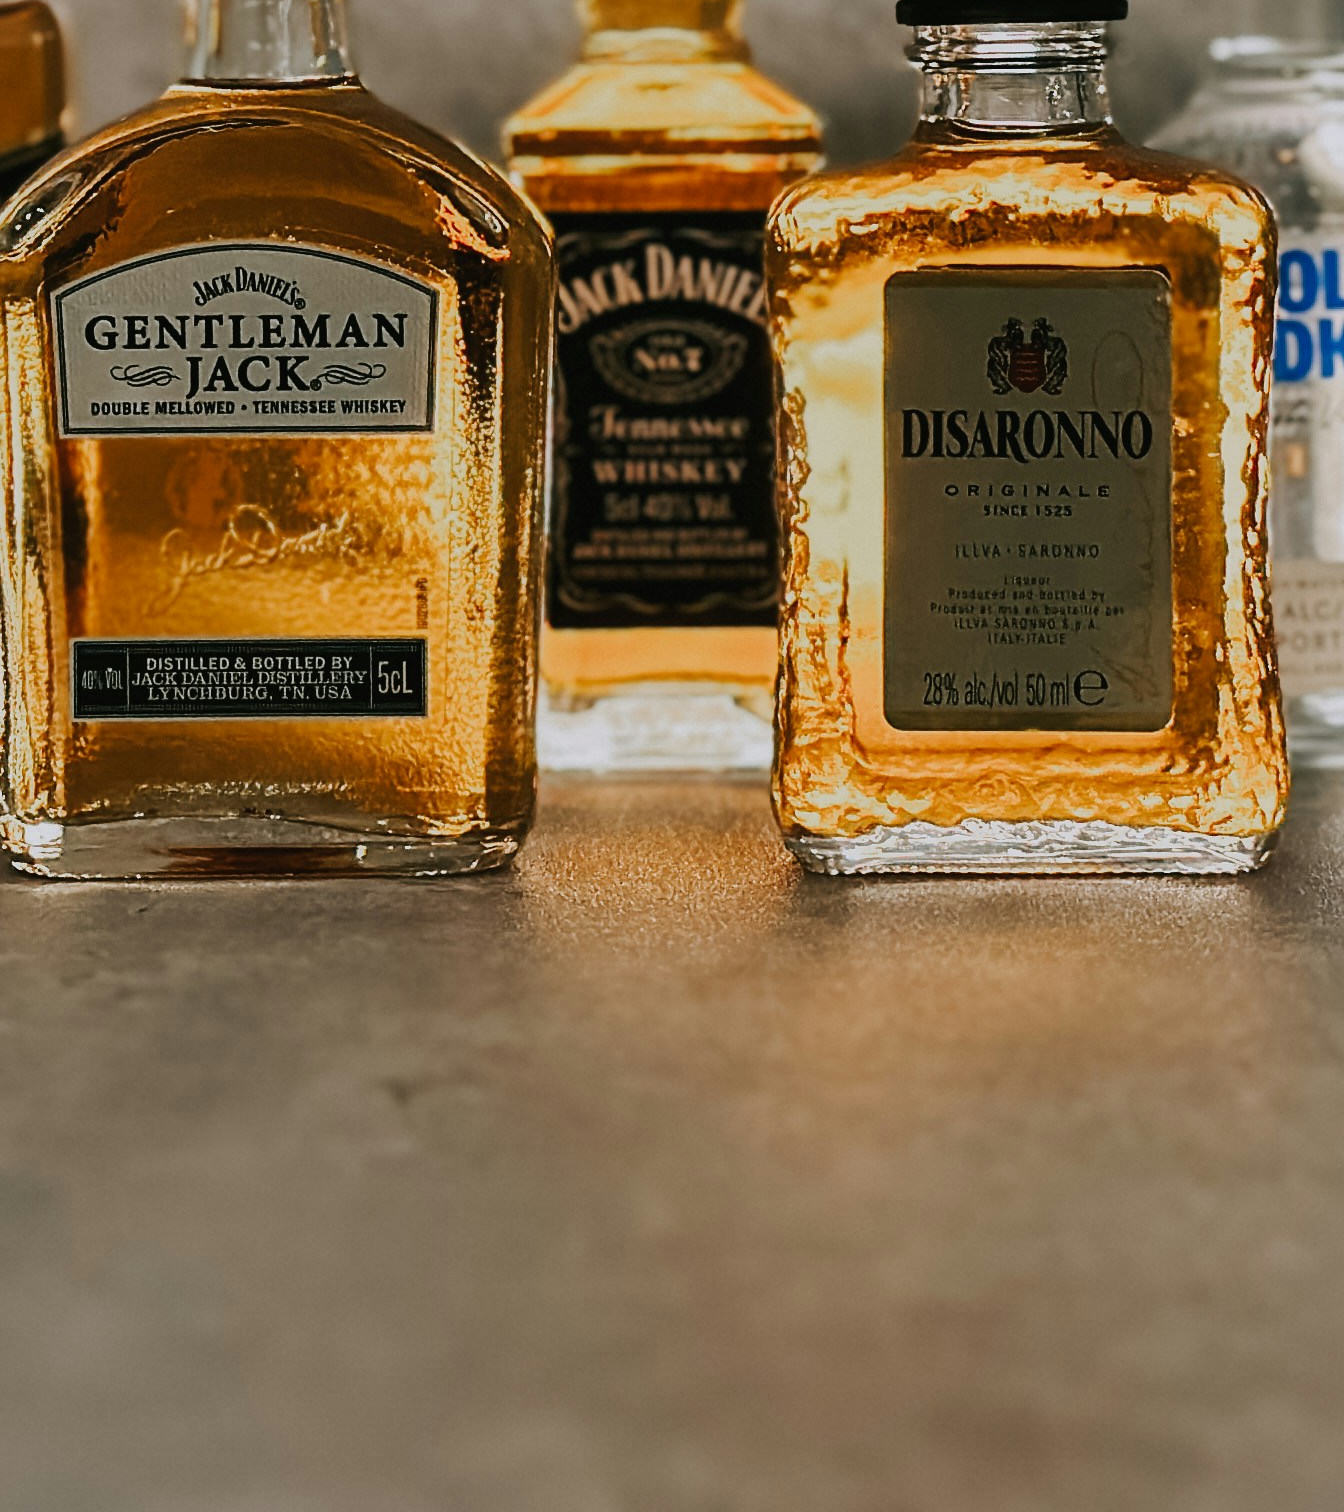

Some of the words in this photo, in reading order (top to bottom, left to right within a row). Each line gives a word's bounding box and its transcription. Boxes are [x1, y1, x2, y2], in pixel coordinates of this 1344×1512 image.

[194, 274, 235, 307] JACK
[558, 260, 645, 335] JACK
[644, 242, 768, 324] DANIEL
[83, 312, 409, 352] GENTLEMAN
[90, 401, 150, 417] DOUBLE
[154, 400, 236, 416] MELLOWED
[252, 399, 337, 415] TENNESSEE
[340, 398, 408, 415] WHISKEY
[901, 408, 1154, 464] DISARONNO
[591, 459, 748, 484] WHISKEY
[944, 483, 1112, 499] ORIGINALE
[983, 504, 1029, 517] SINCE
[1035, 503, 1074, 517] 1525
[954, 543, 1002, 559] ILLVA
[1017, 543, 1100, 559] SARONNO
[146, 656, 230, 671] DISTILLED
[233, 656, 247, 671] &
[251, 656, 326, 670] BOTTLED
[331, 656, 353, 670] BY
[81, 670, 104, 690] 40%
[104, 669, 124, 690] VOL
[131, 671, 178, 686] JACK
[181, 671, 254, 686] DANIEL
[256, 670, 368, 685] DISTILLERY
[147, 686, 274, 701] LYNCHBURG,
[278, 685, 311, 700] TN.
[314, 684, 353, 700] USA
[922, 671, 959, 706] 28%
[1025, 672, 1046, 707] 50
[1049, 671, 1070, 706] ml
